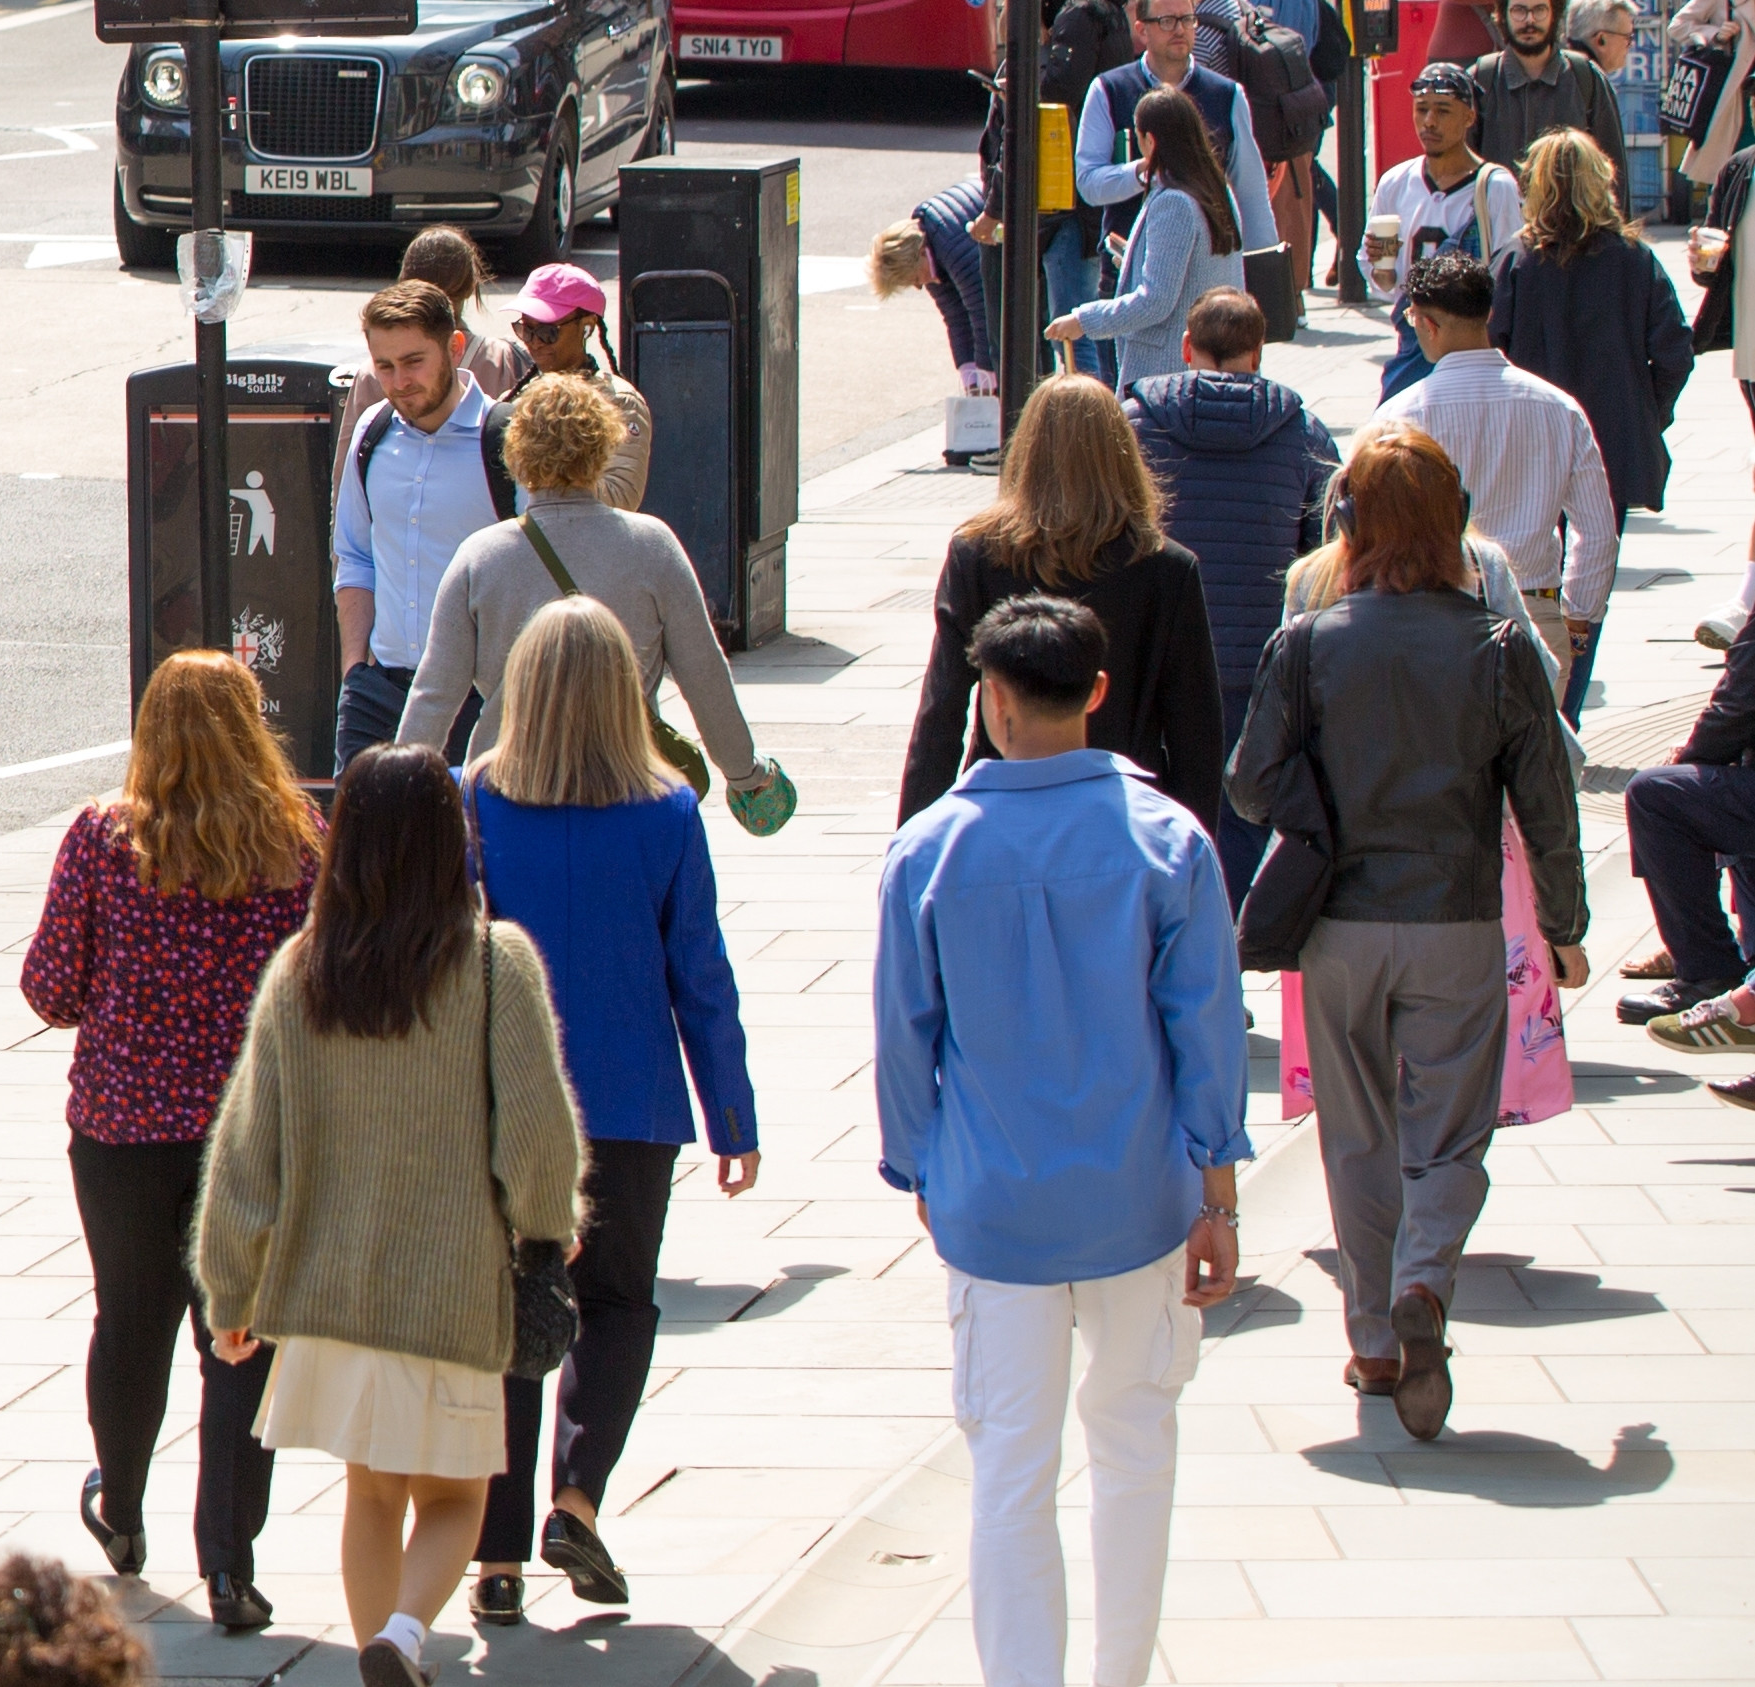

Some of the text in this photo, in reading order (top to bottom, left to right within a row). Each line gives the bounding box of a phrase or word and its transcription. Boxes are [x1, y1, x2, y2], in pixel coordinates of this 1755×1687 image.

[691, 37, 773, 57] SN14 TYO
[260, 168, 358, 192] KE19 WBL
